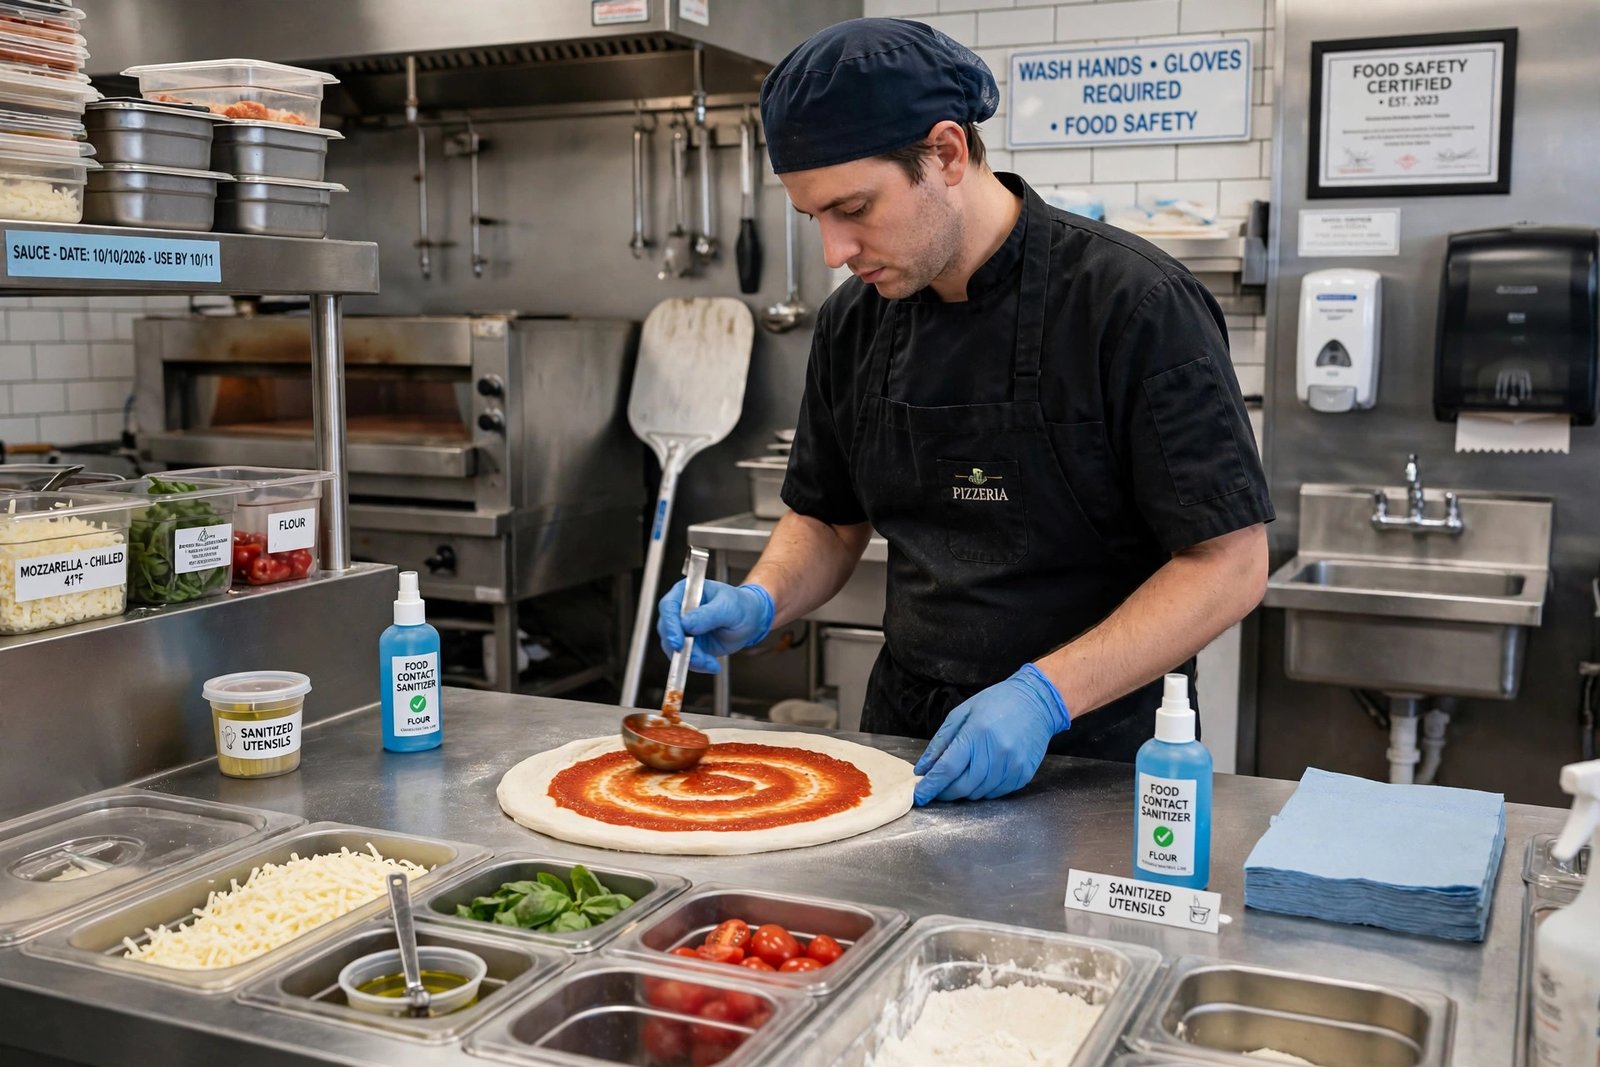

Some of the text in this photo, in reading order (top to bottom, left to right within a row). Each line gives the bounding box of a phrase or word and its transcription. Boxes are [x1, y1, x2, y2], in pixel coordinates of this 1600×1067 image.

[1018, 49, 1242, 81] WASH HANDS GLOVES
[1353, 58, 1468, 79] FOOD SAFETY
[1083, 80, 1182, 104] REQUIRED
[1367, 76, 1452, 94] CERTIFIED
[1065, 110, 1198, 135] FOOD SAFETY
[13, 244, 50, 260] SAUCE
[59, 246, 90, 262] DATE:
[93, 247, 146, 265] 10/10/2026
[154, 251, 173, 265] USE
[175, 252, 188, 266] BY
[190, 253, 214, 267] 10/11
[952, 486, 1009, 501] PIZZERIA
[279, 517, 306, 532] FLOUR
[20, 558, 83, 578] MOZZARELLA
[89, 552, 124, 568] CHILLED
[64, 573, 84, 586] 41°F
[405, 661, 428, 670] FOOD
[397, 669, 434, 681] CONTACT
[396, 680, 436, 691] SANITIZER
[408, 716, 430, 725] FLOUR
[241, 722, 293, 738] SANITIZED
[243, 736, 291, 750] UTENSILS
[1151, 784, 1179, 796] FOOD
[1143, 794, 1189, 810] CONTACT
[1142, 806, 1190, 822] SANITIZER
[1149, 850, 1178, 862] FLOUR
[1109, 882, 1172, 903] SANITIZED
[1109, 897, 1166, 917] UTENSILS
